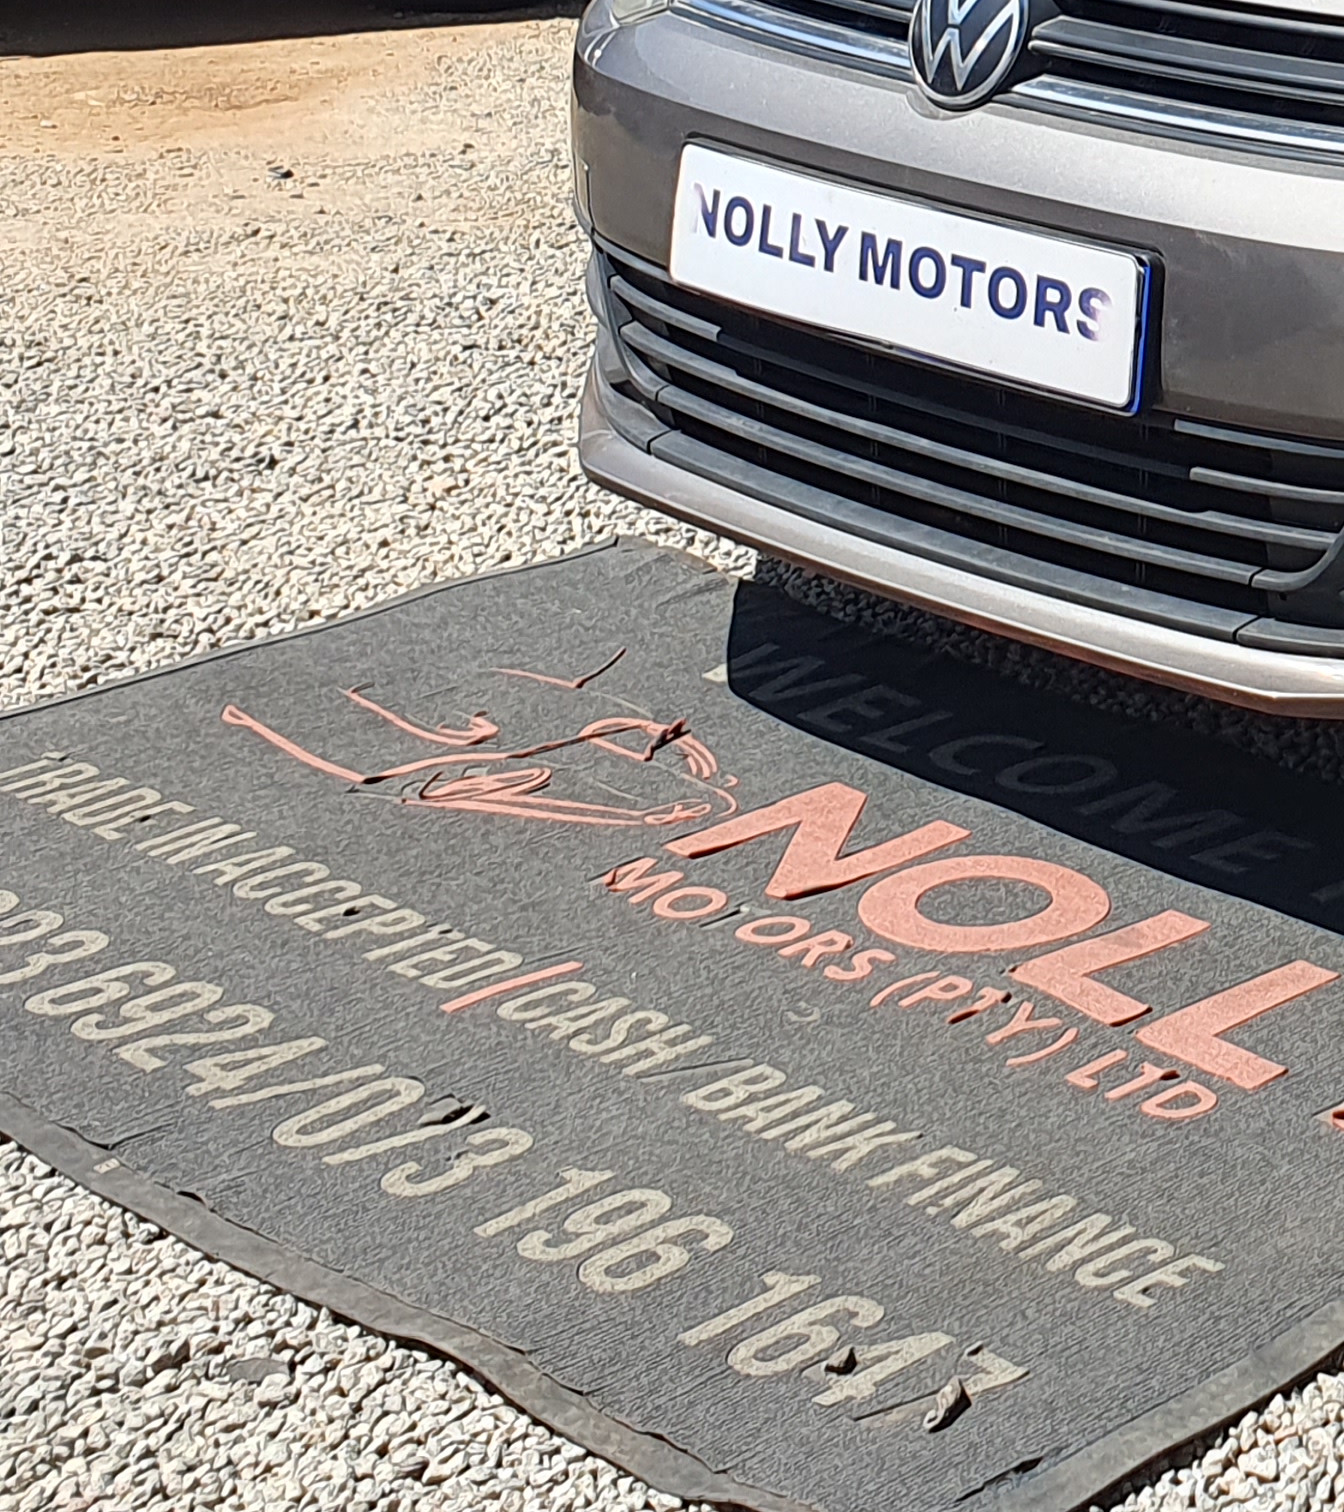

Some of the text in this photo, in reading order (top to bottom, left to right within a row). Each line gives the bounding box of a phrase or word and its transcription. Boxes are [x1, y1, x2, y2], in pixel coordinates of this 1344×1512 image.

[691, 182, 1112, 342] NOLLY MOTORS
[703, 643, 1313, 875] WELCOME
[0, 751, 197, 839] TRADE
[135, 817, 258, 864] IN
[866, 1144, 1225, 1308] FINANCE
[870, 972, 1078, 1067] (PTY)
[1065, 1049, 1218, 1120] LTD
[474, 1166, 732, 1292] 196
